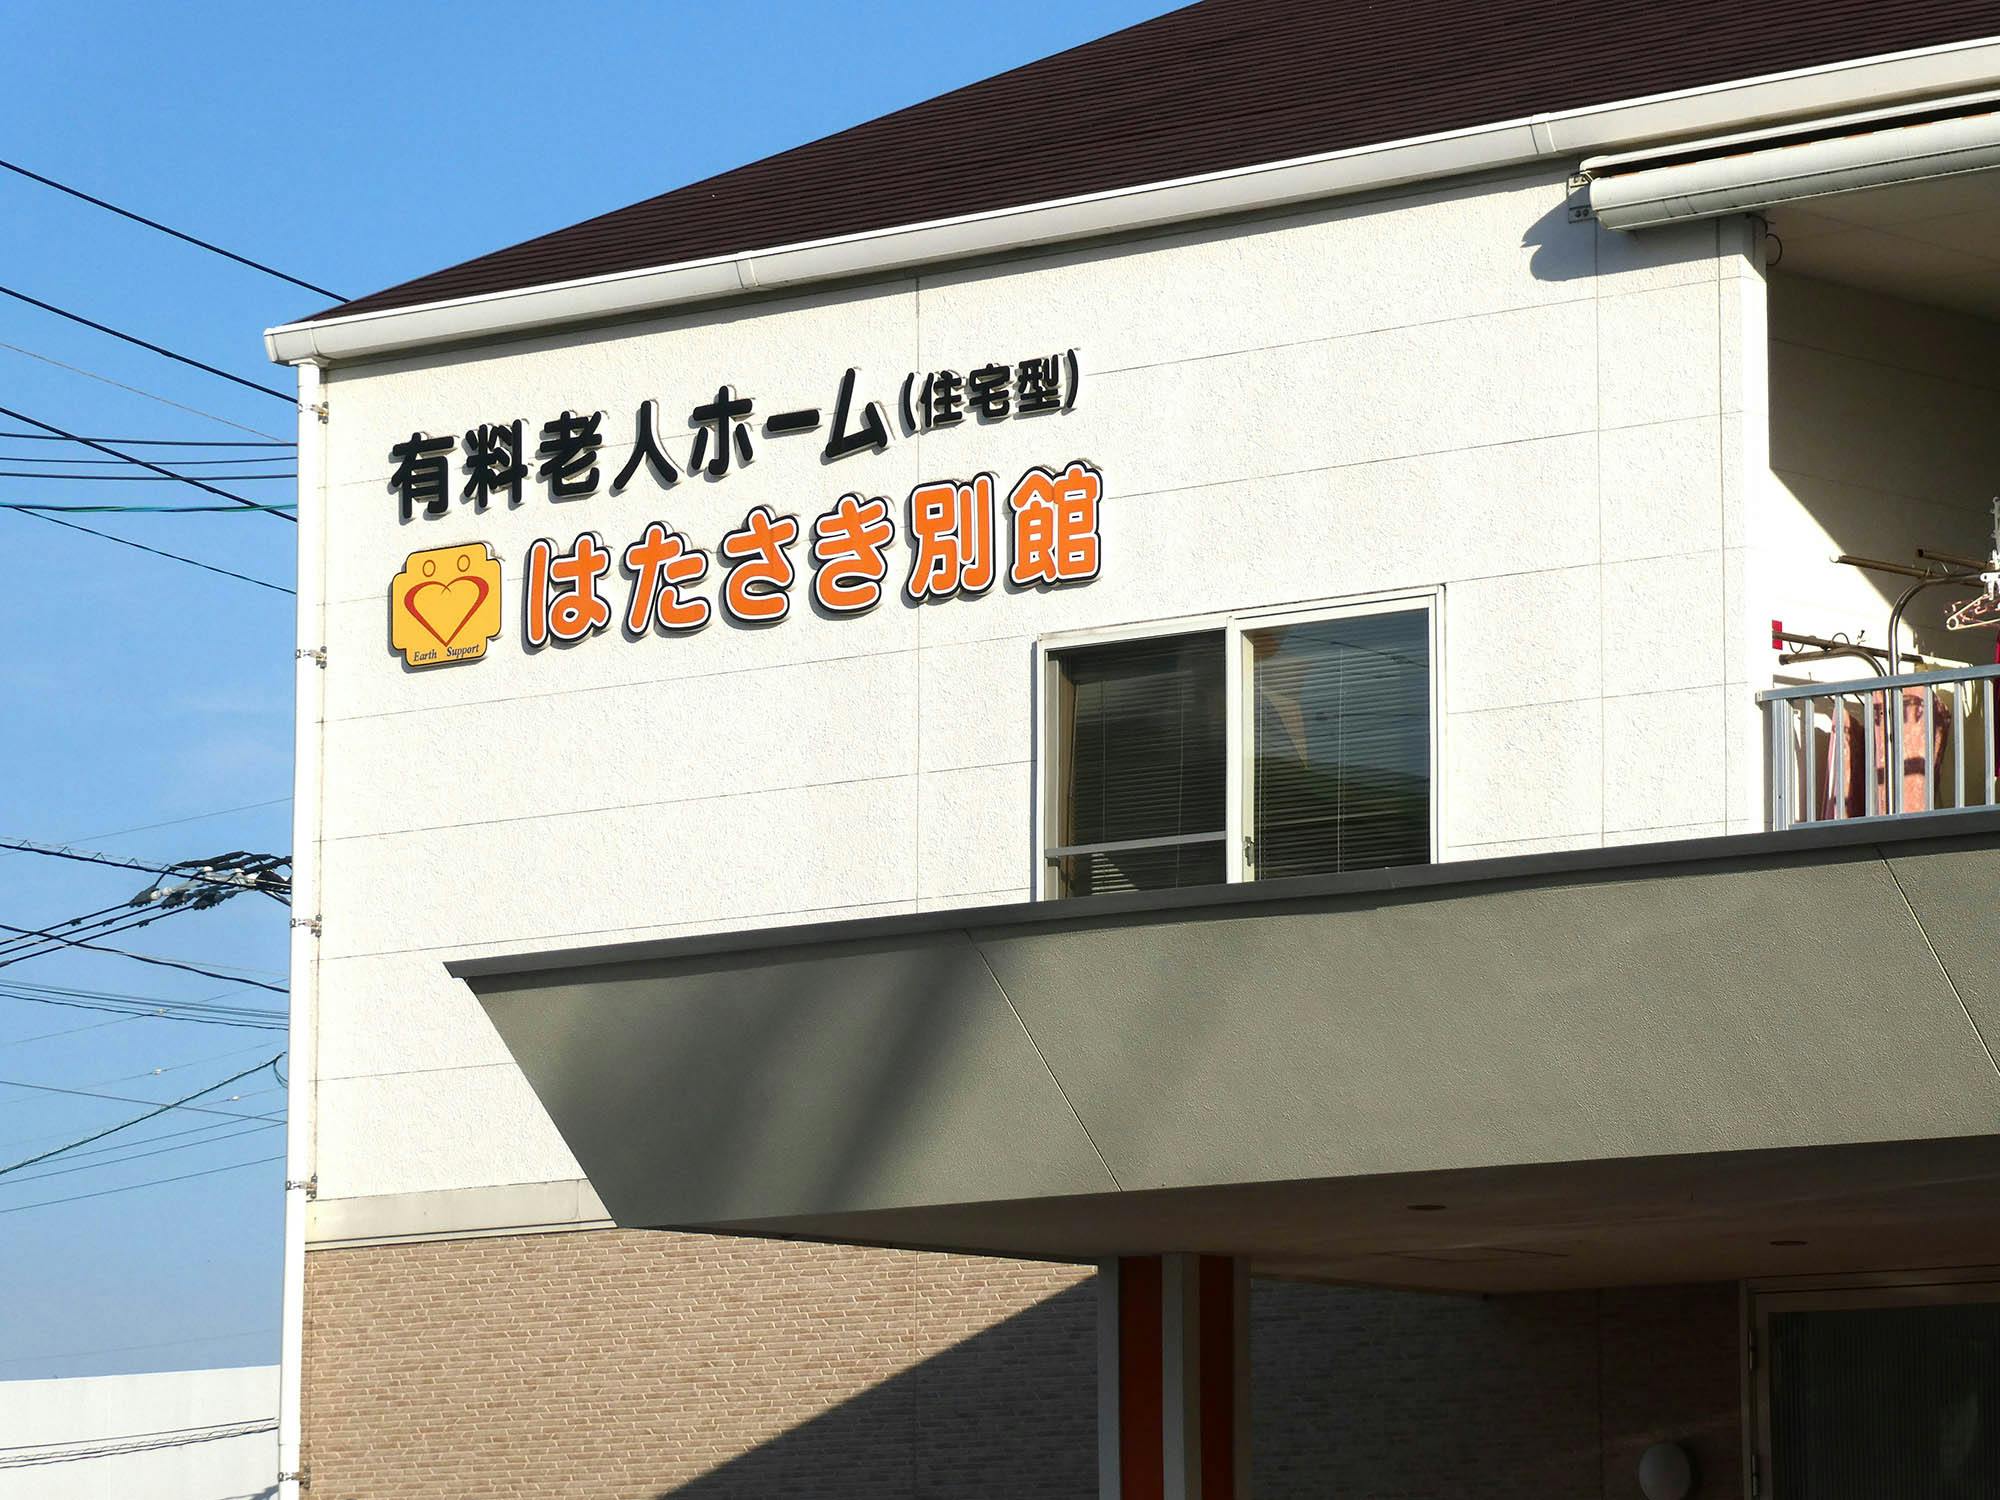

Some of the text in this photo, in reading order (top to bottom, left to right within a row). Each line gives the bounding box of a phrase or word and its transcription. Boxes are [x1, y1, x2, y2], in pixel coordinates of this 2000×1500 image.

[525, 461, 1102, 647] はたさき別館
[413, 644, 480, 661] Earth Support
